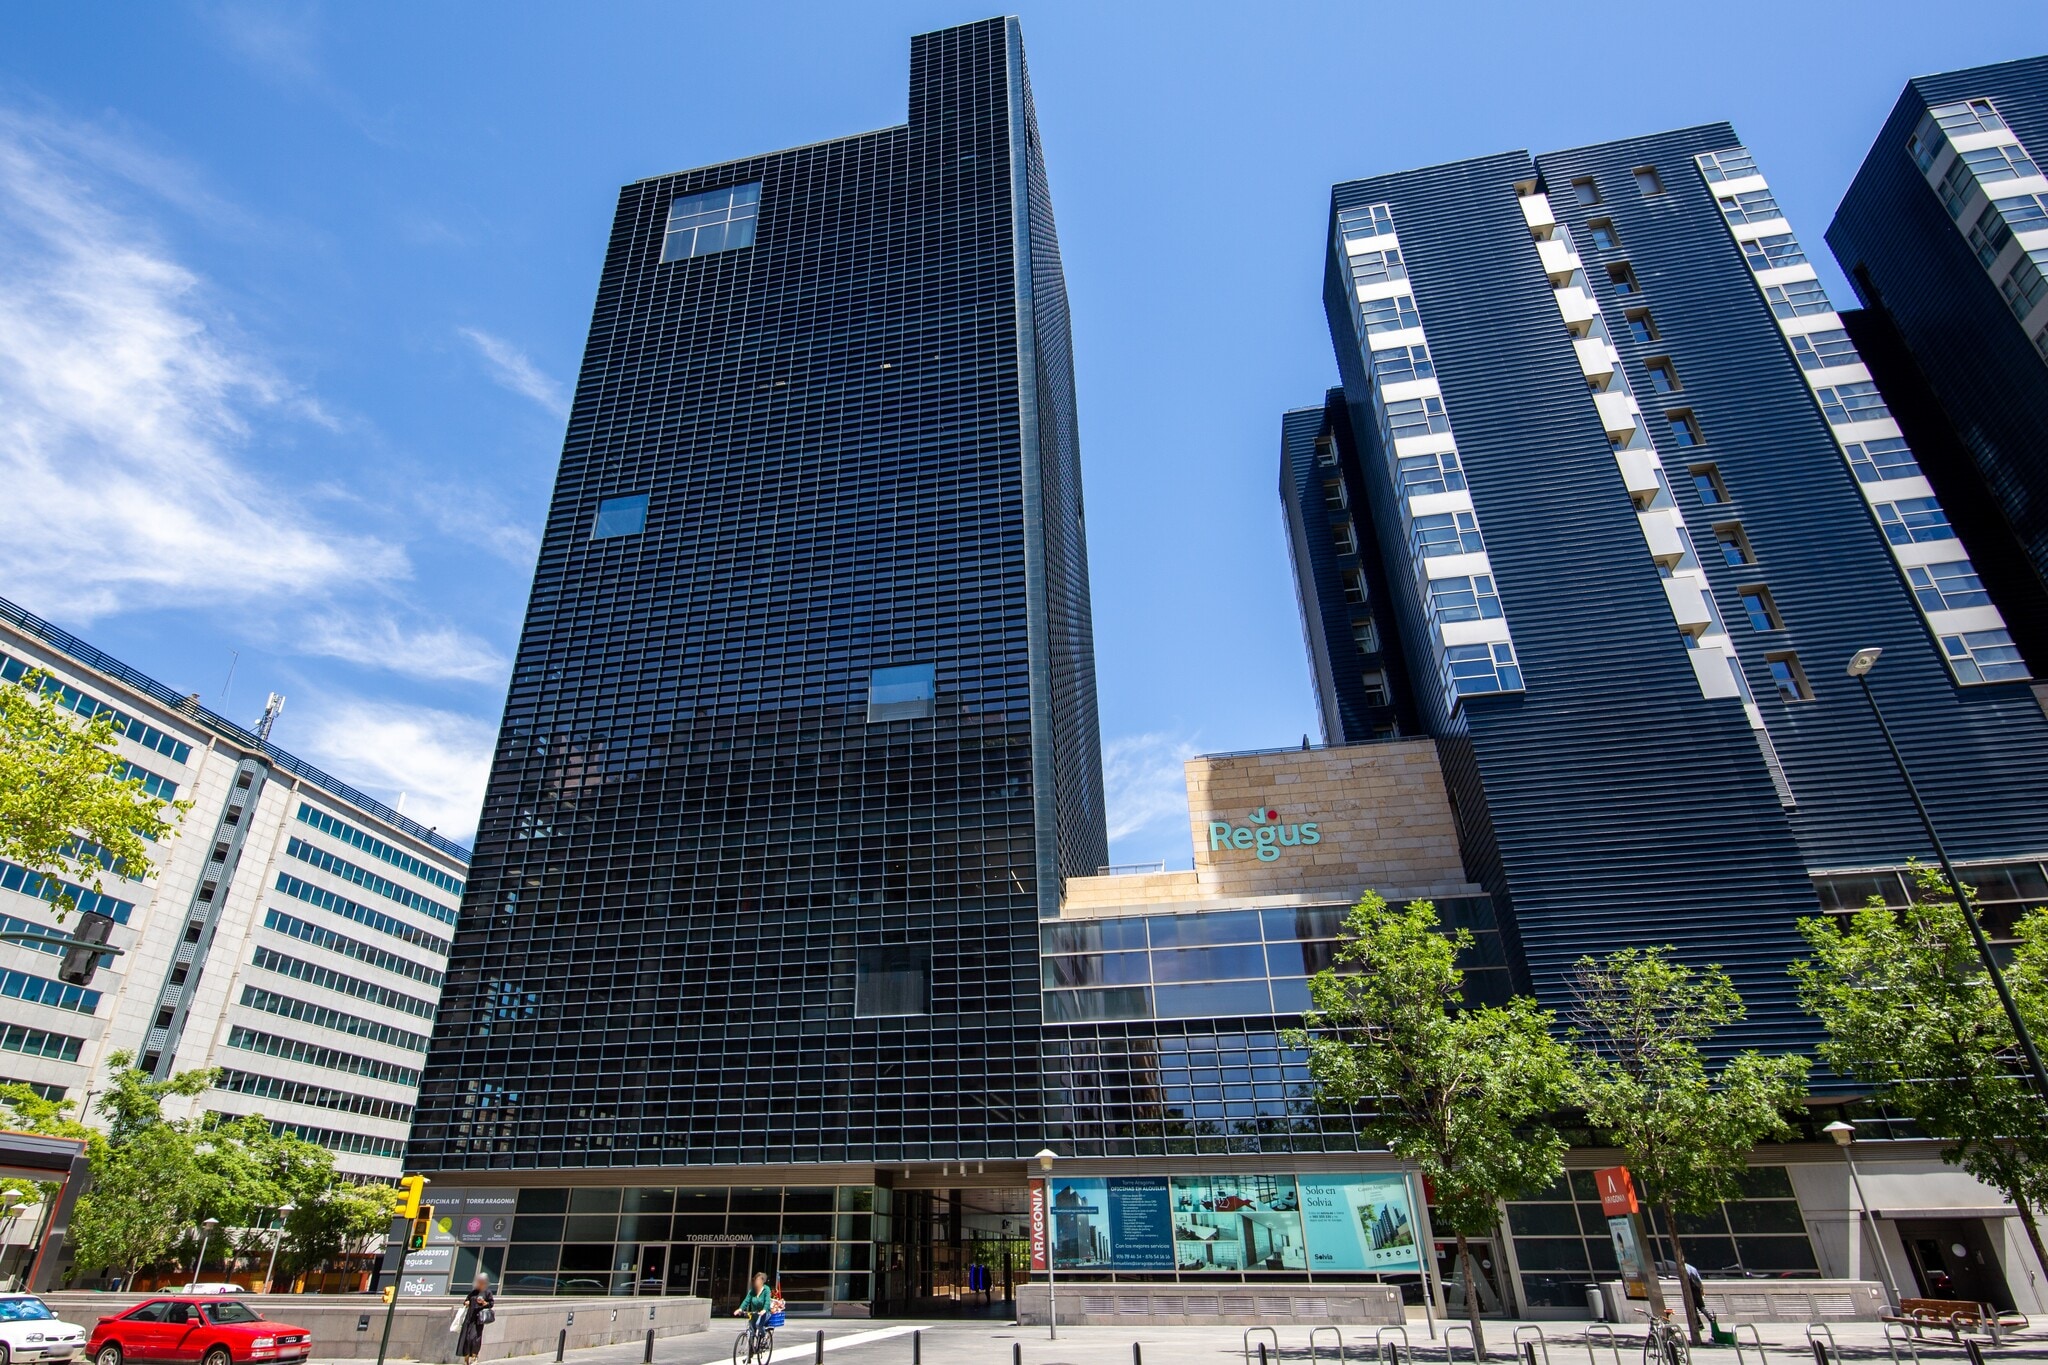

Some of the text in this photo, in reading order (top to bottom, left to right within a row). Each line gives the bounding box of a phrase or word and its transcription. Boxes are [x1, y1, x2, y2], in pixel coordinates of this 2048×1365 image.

[1209, 820, 1321, 862] Regus
[1305, 1185, 1324, 1195] Solo
[1307, 1197, 1332, 1207] Solvia
[1032, 1188, 1044, 1261] ARAGONIA
[404, 1281, 433, 1296] Regus
